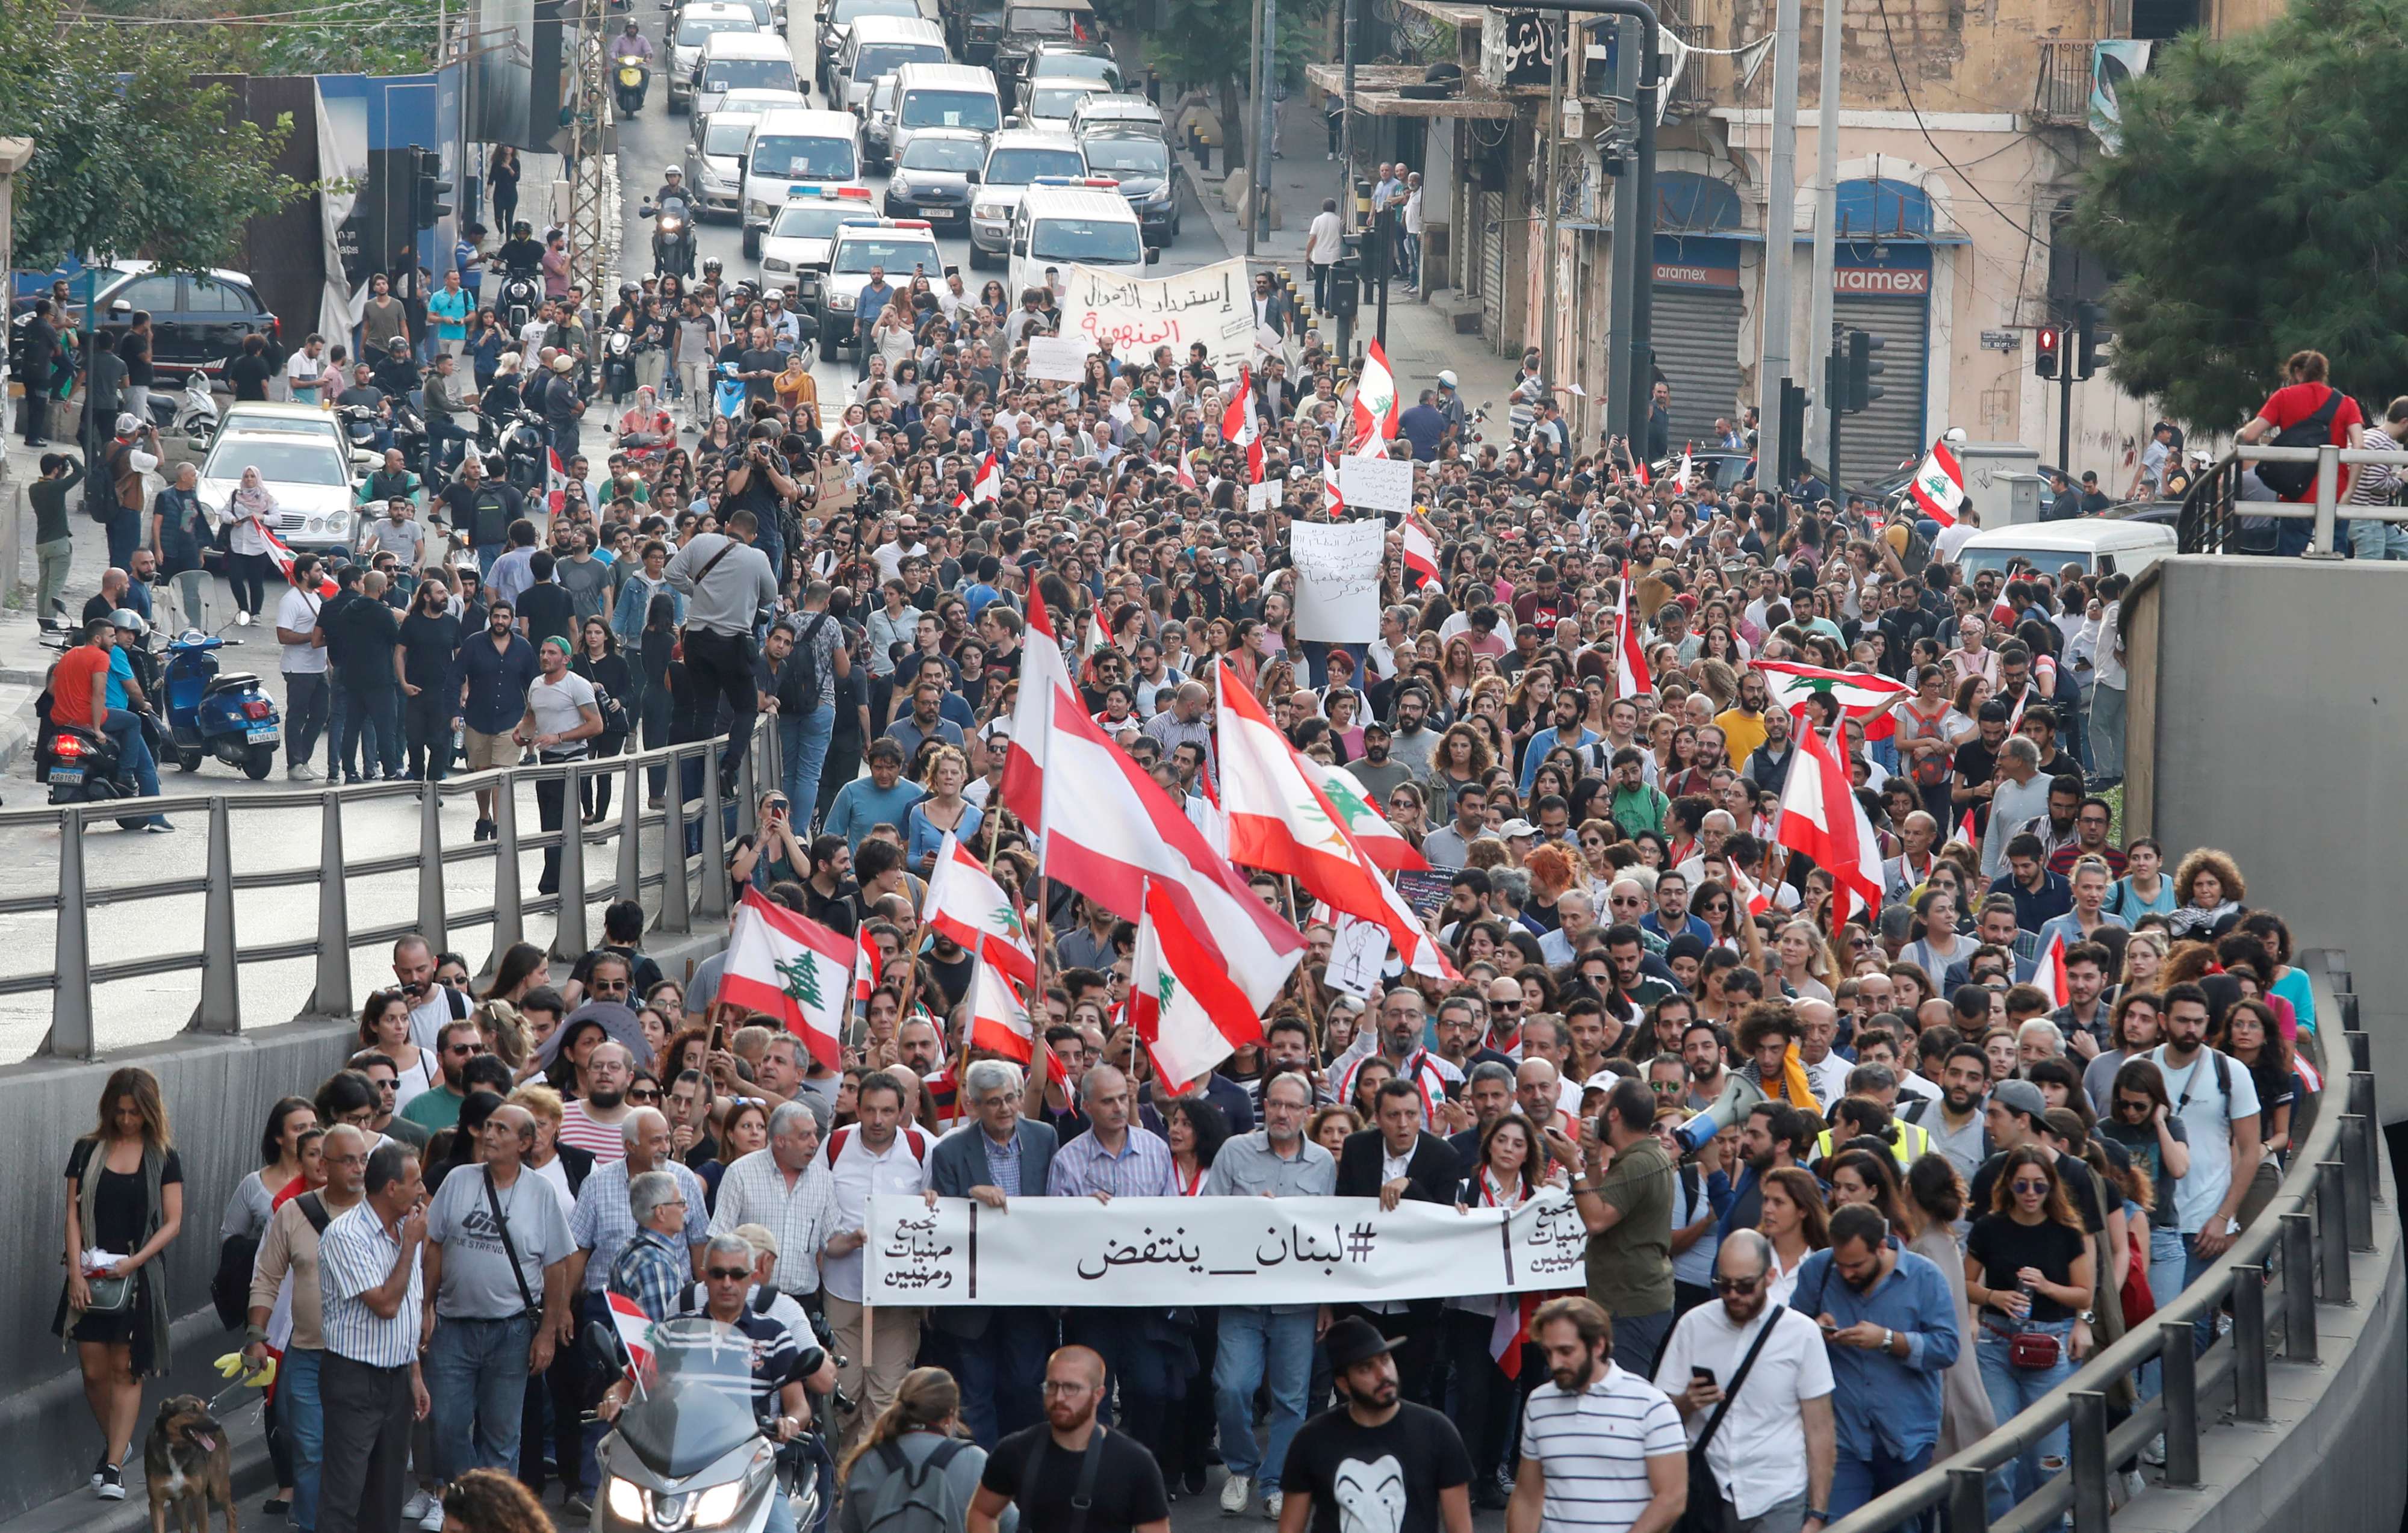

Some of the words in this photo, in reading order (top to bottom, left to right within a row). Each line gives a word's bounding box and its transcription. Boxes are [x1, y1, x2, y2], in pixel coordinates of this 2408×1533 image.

[792, 157, 805, 171] 4
[1657, 266, 1706, 282] aramex
[1834, 271, 1923, 291] ramex
[895, 1206, 940, 1240] تجمع
[885, 1235, 953, 1263] مهنيات
[884, 1265, 952, 1289] ومهنيين
